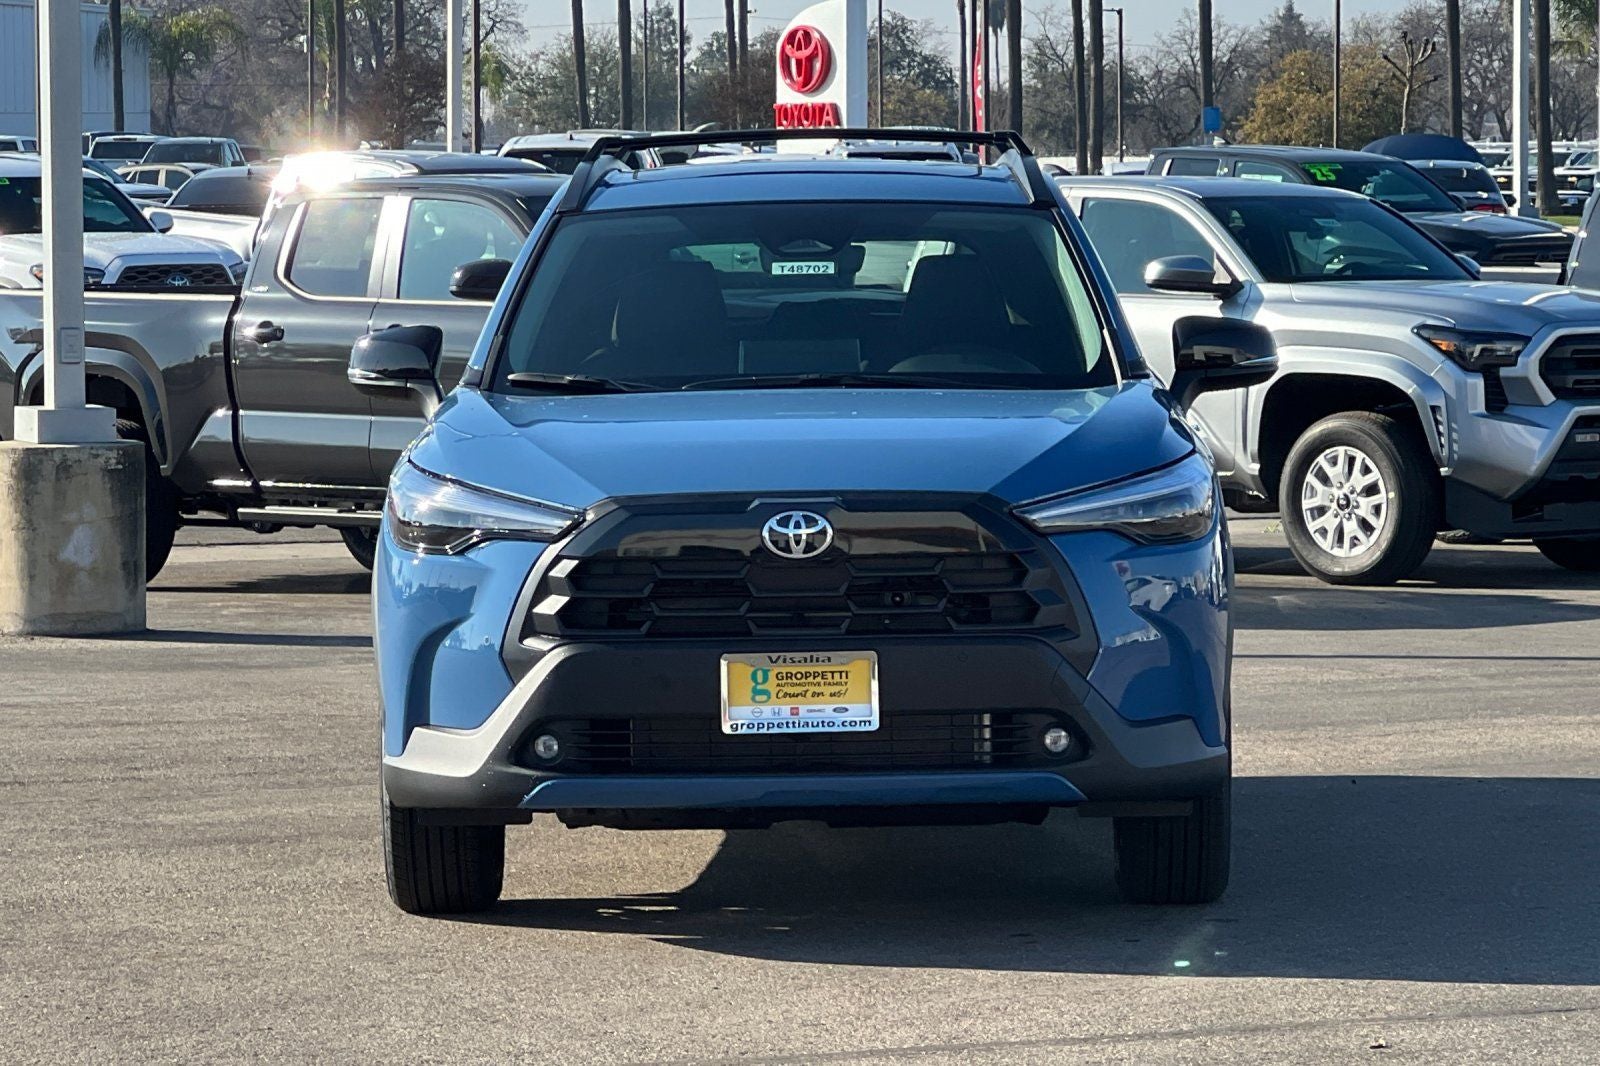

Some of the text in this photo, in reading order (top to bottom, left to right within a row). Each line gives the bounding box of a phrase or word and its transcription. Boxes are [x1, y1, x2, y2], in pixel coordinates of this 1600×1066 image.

[773, 103, 835, 128] TOYOTA
[779, 264, 829, 274] T48702
[767, 654, 832, 665] Visalia
[775, 670, 849, 681] GROPPETTI
[751, 667, 772, 704] g
[775, 688, 809, 700] Count
[811, 690, 825, 698] on
[730, 719, 872, 732] groppettiauto.com
